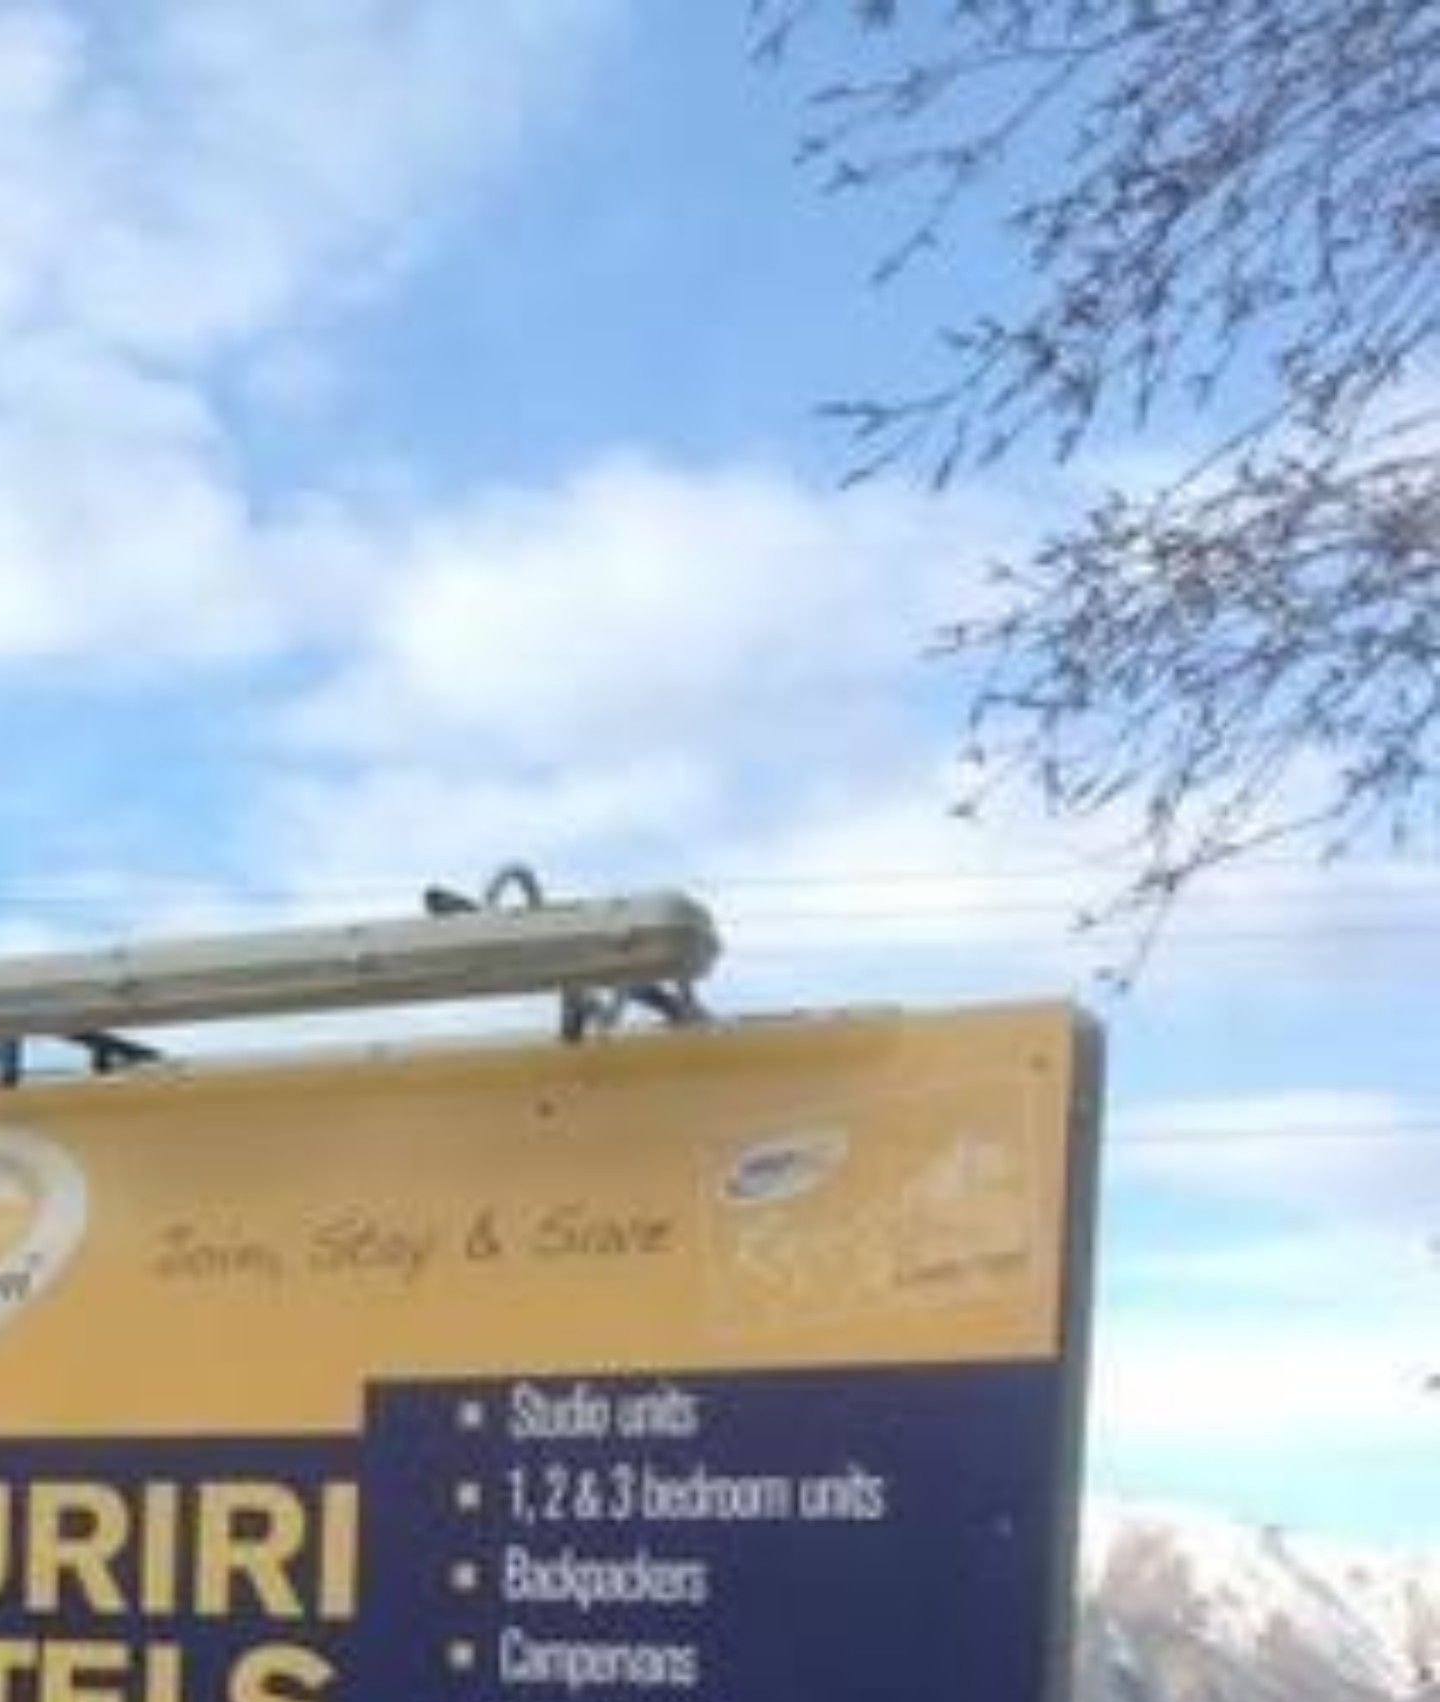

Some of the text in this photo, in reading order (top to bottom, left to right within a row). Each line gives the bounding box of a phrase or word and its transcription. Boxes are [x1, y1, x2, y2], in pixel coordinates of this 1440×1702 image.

[510, 1381, 700, 1440] Studio units
[542, 1463, 568, 1520] 2
[573, 1466, 603, 1520] &
[608, 1461, 636, 1520] 3
[641, 1460, 791, 1520] bedroom
[797, 1461, 886, 1520] units
[502, 1544, 708, 1611] Backpackers
